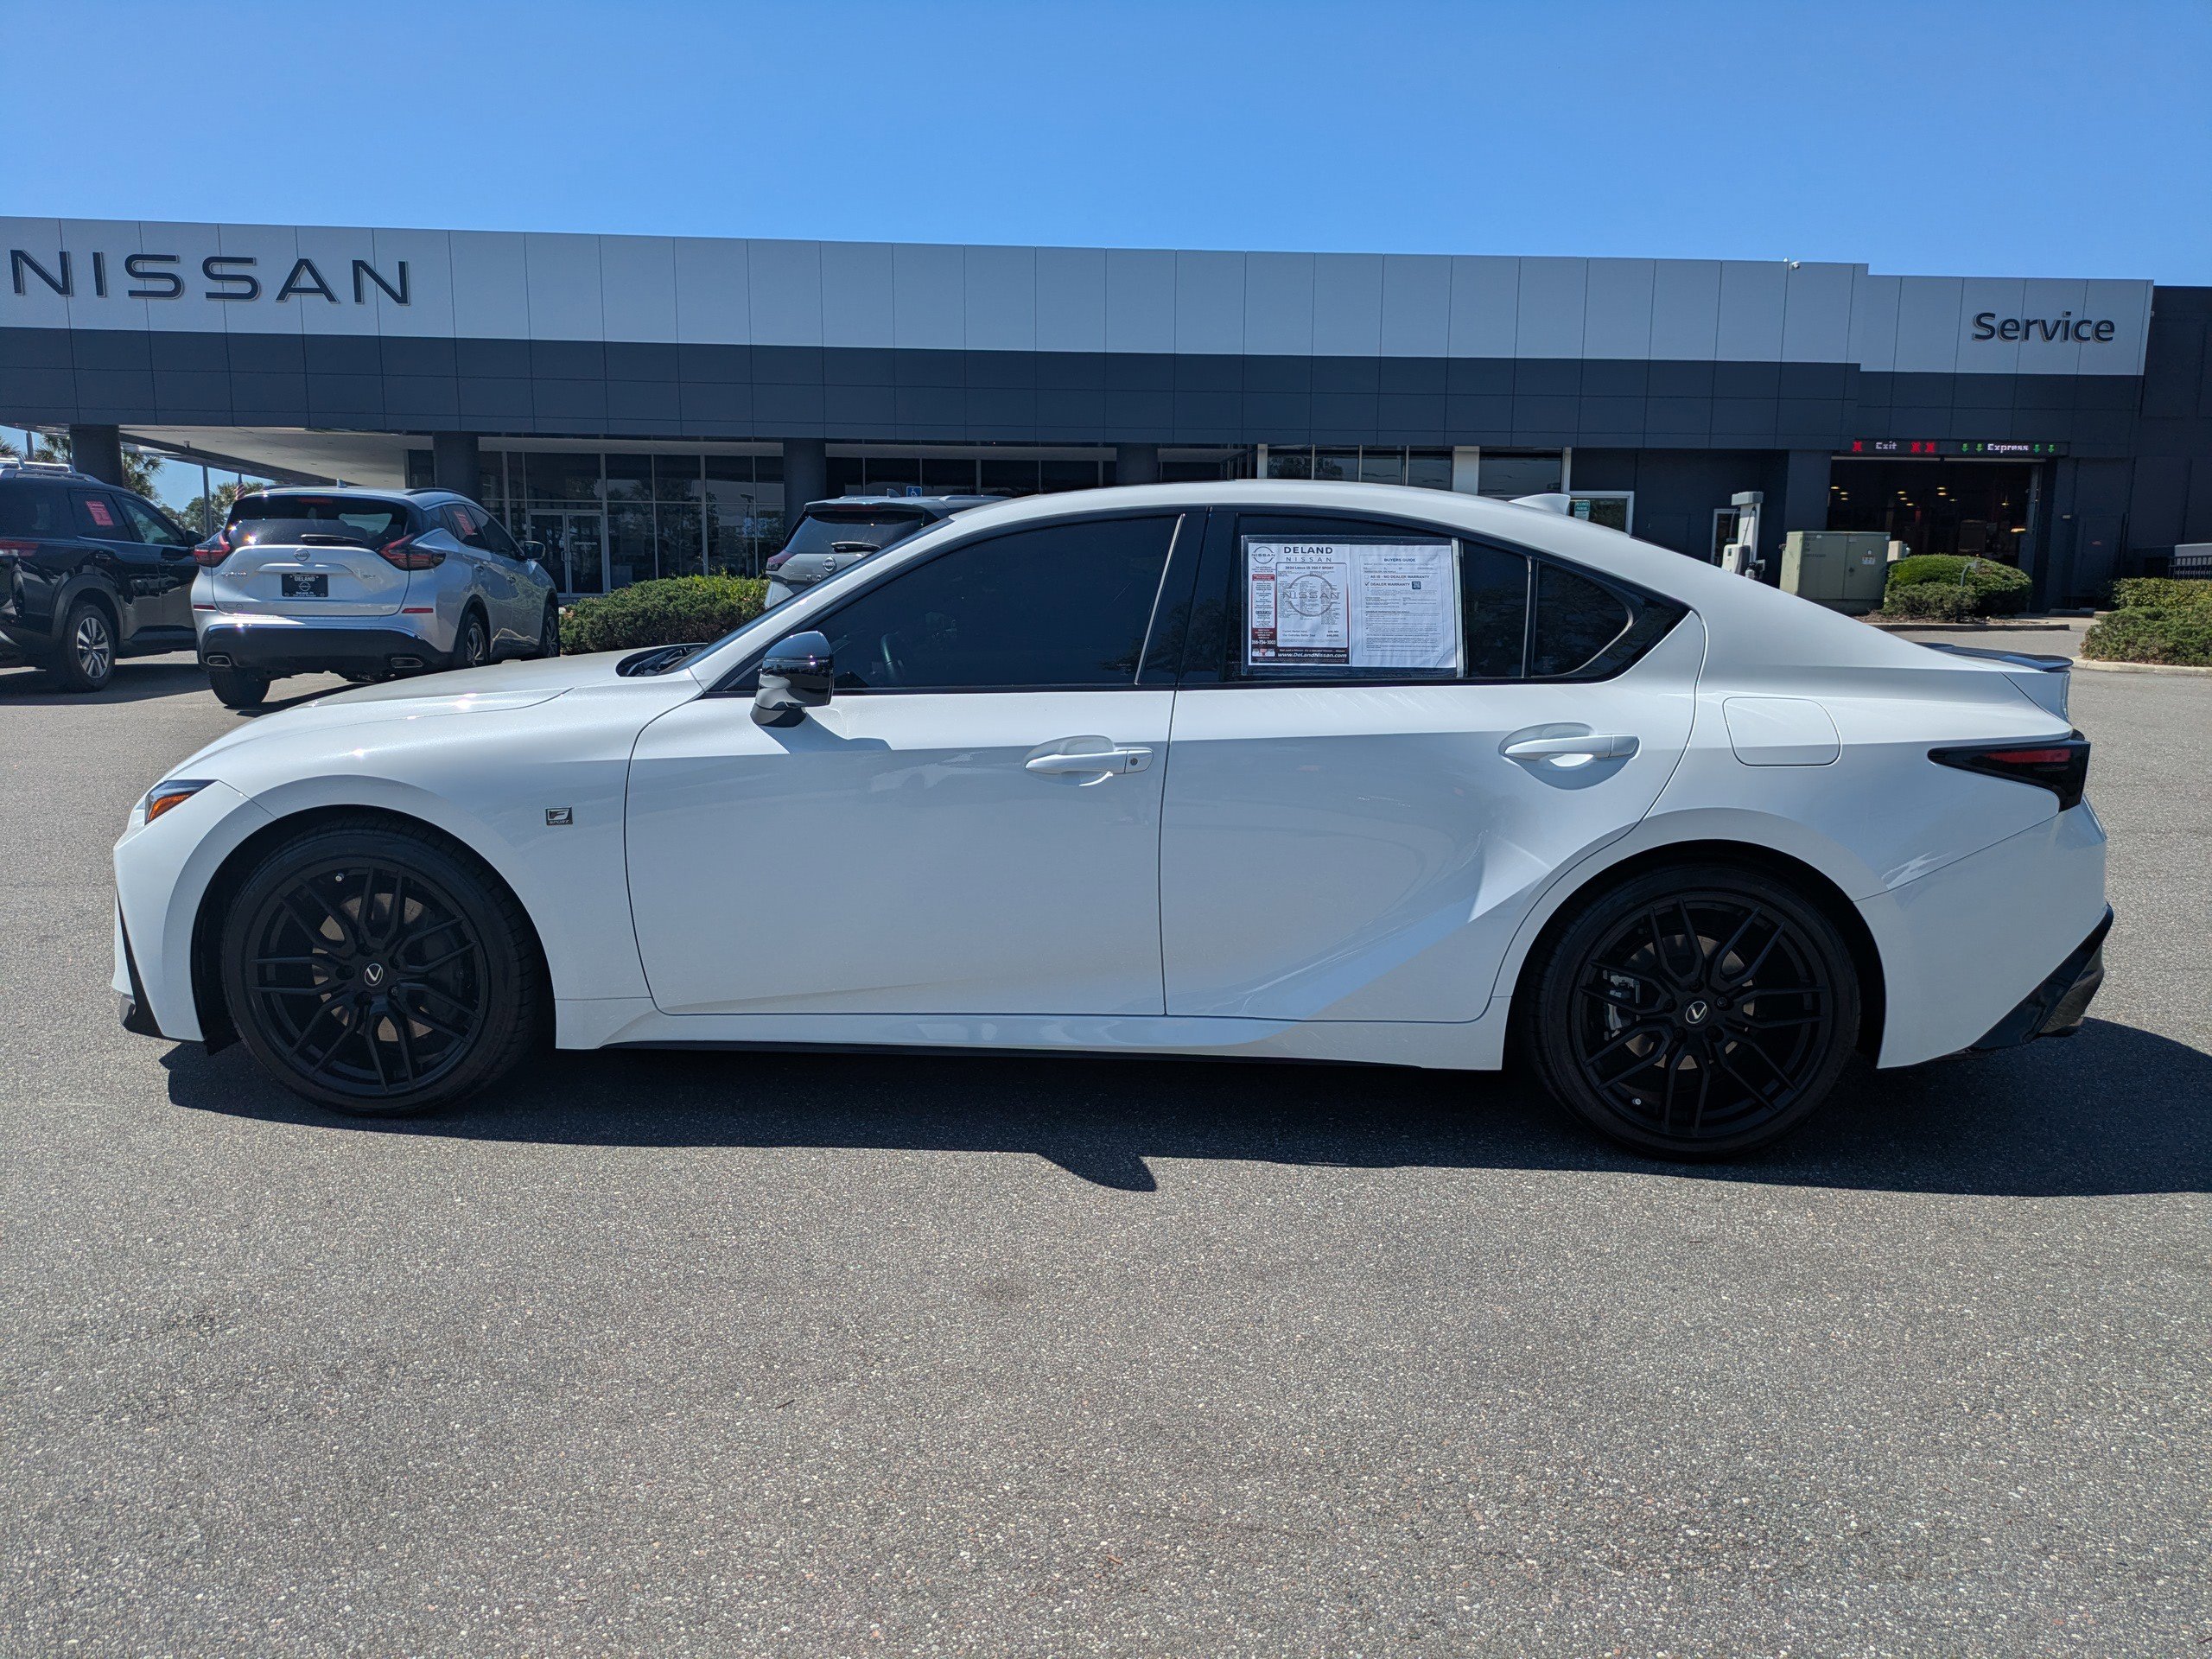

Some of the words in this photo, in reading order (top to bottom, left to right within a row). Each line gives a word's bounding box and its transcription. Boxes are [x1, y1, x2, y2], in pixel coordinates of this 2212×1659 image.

[10, 249, 410, 306] NISSAN
[1974, 311, 2116, 343] Service
[1875, 441, 1897, 449] Exit
[1987, 443, 2029, 453] Express
